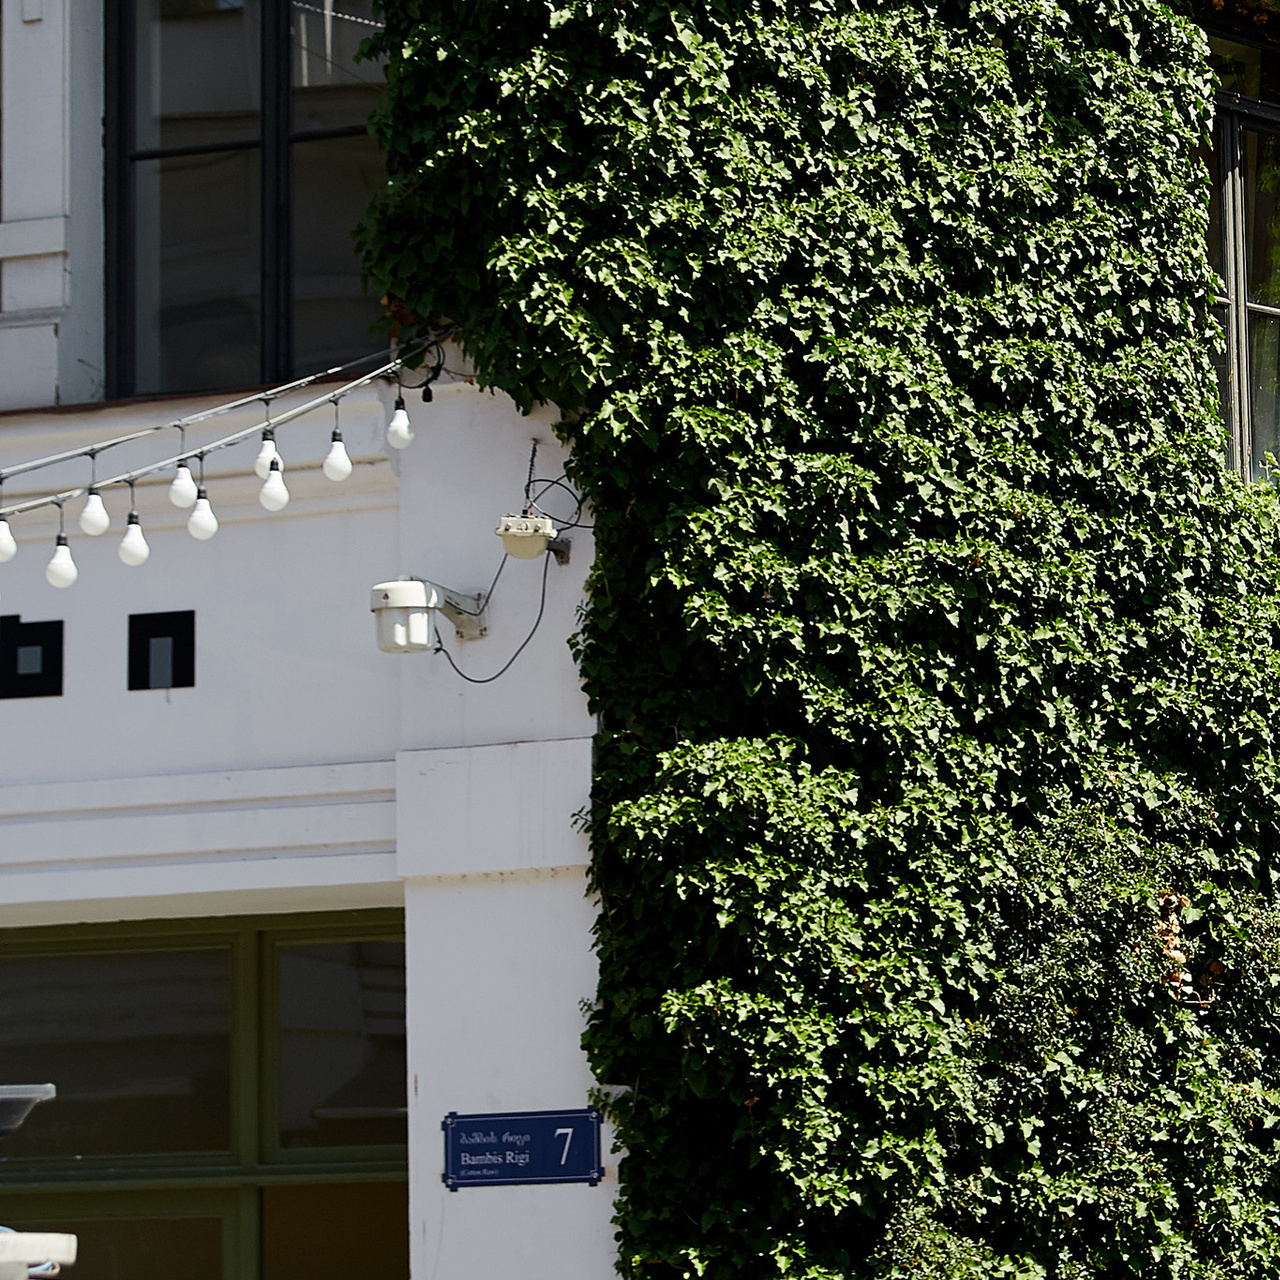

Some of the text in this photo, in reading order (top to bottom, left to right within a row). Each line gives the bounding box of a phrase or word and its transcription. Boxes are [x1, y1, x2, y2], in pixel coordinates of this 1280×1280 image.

[460, 1149, 530, 1166] Bambis Rigi
[554, 1127, 574, 1165] 7
